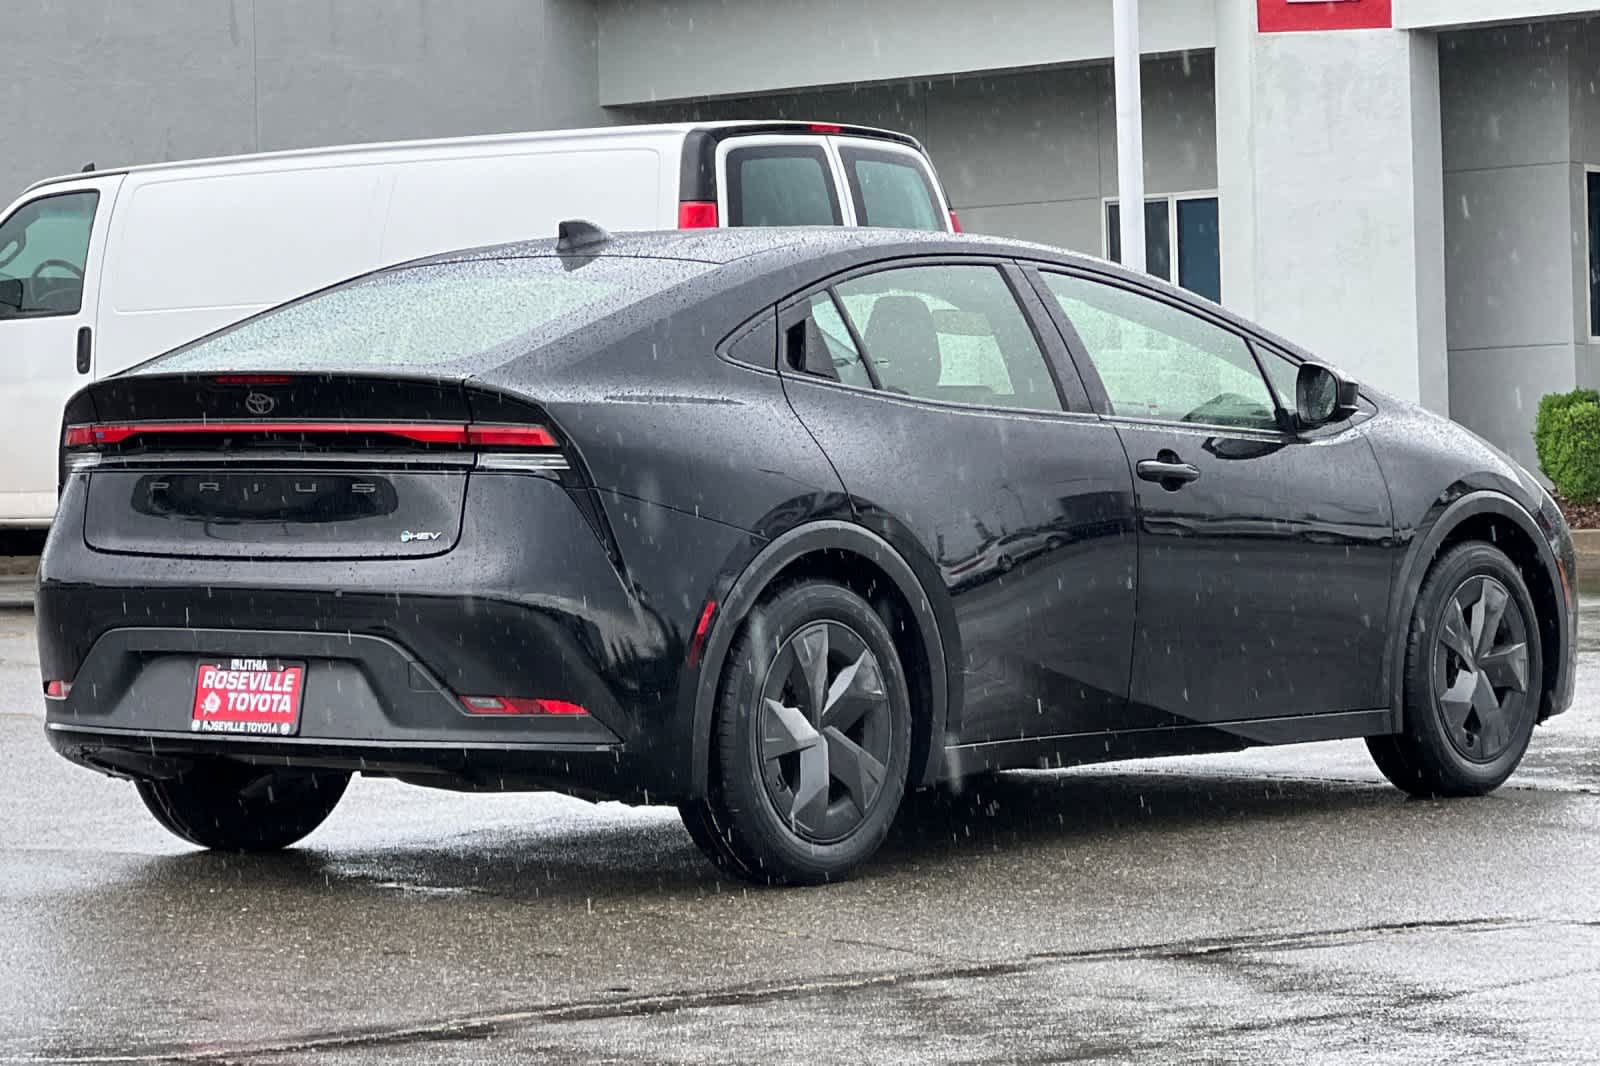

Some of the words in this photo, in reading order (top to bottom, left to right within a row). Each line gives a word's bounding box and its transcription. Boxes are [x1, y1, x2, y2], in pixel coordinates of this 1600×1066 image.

[150, 482, 376, 493] PRIUS
[239, 659, 268, 670] LITHIA
[203, 671, 295, 691] ROSEVILLE
[227, 692, 291, 712] TOYOTA
[202, 720, 245, 731] ROSEVILLE
[247, 722, 278, 733] TOYOTA
